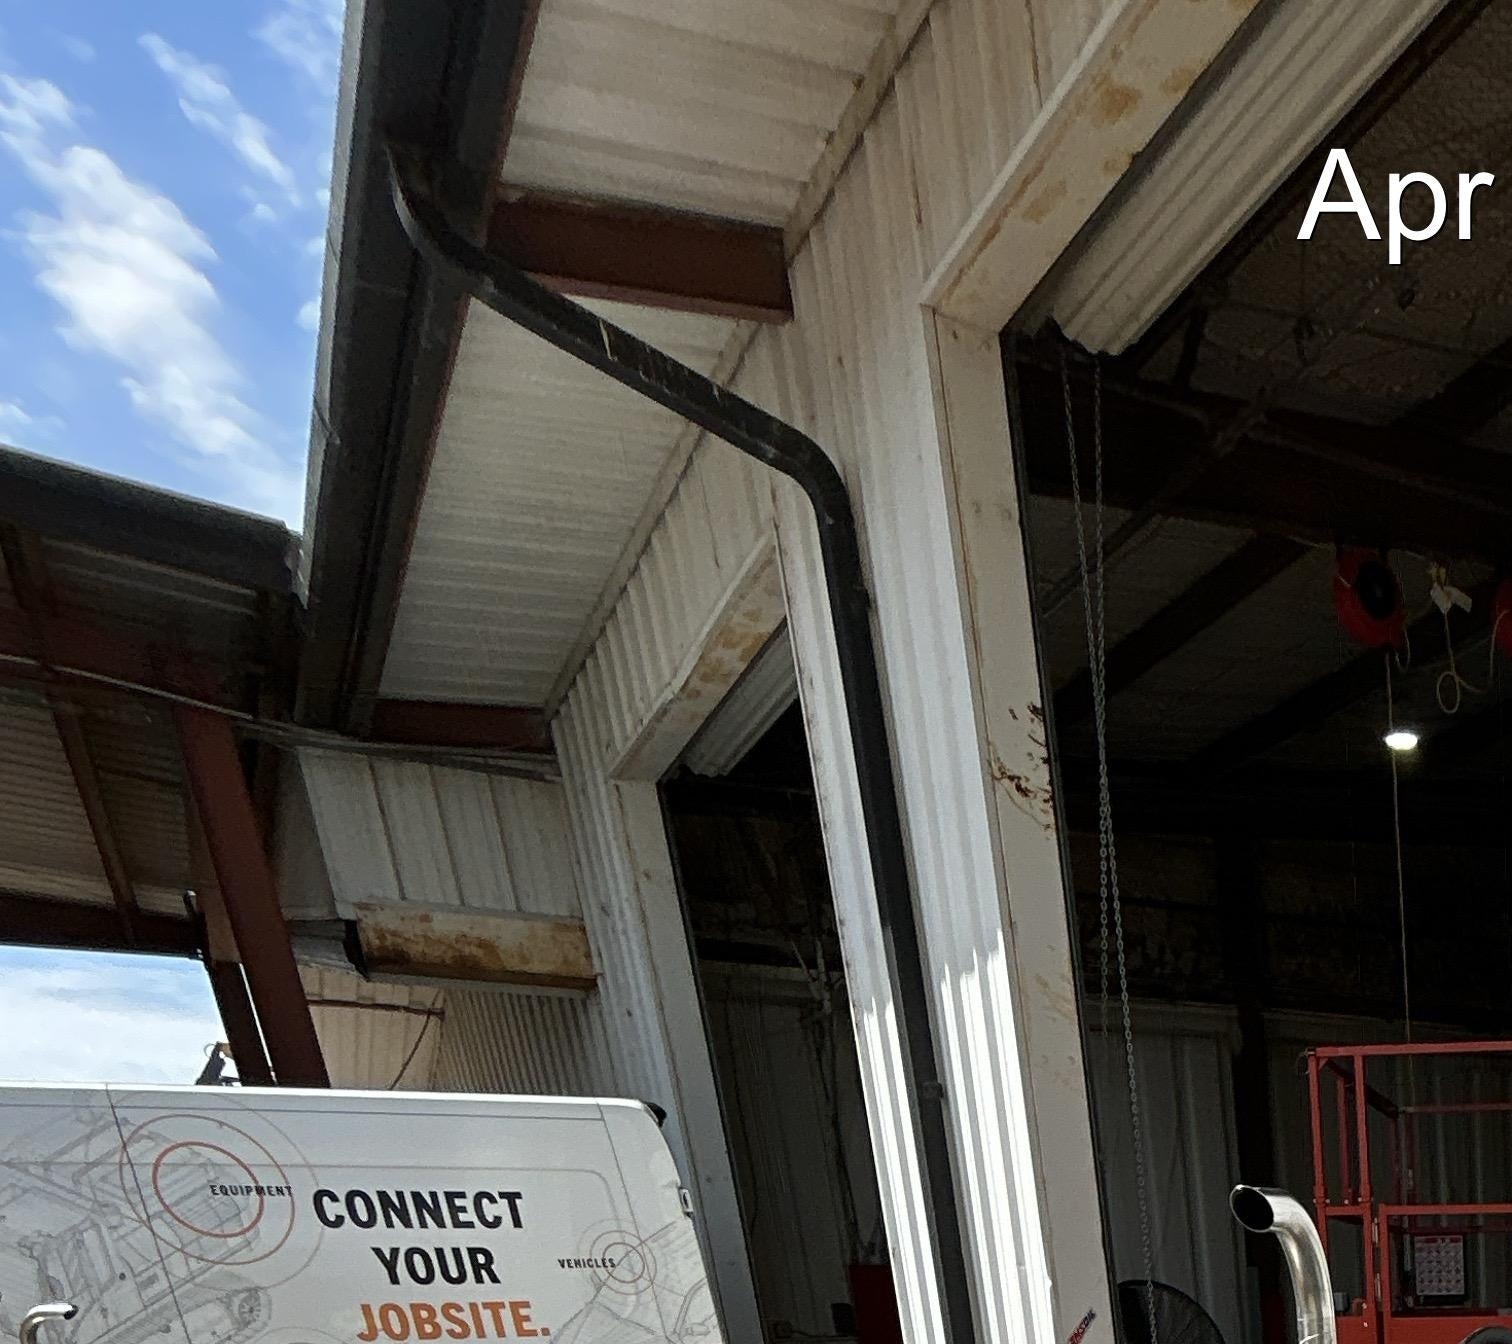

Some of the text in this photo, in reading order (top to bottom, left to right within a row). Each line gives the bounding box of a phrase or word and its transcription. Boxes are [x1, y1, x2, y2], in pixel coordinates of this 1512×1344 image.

[209, 1184, 293, 1198] EQUIPMENT
[312, 1188, 524, 1229] CONNECT
[369, 1246, 501, 1285] YOUR
[356, 1300, 551, 1342] JOBSITE.
